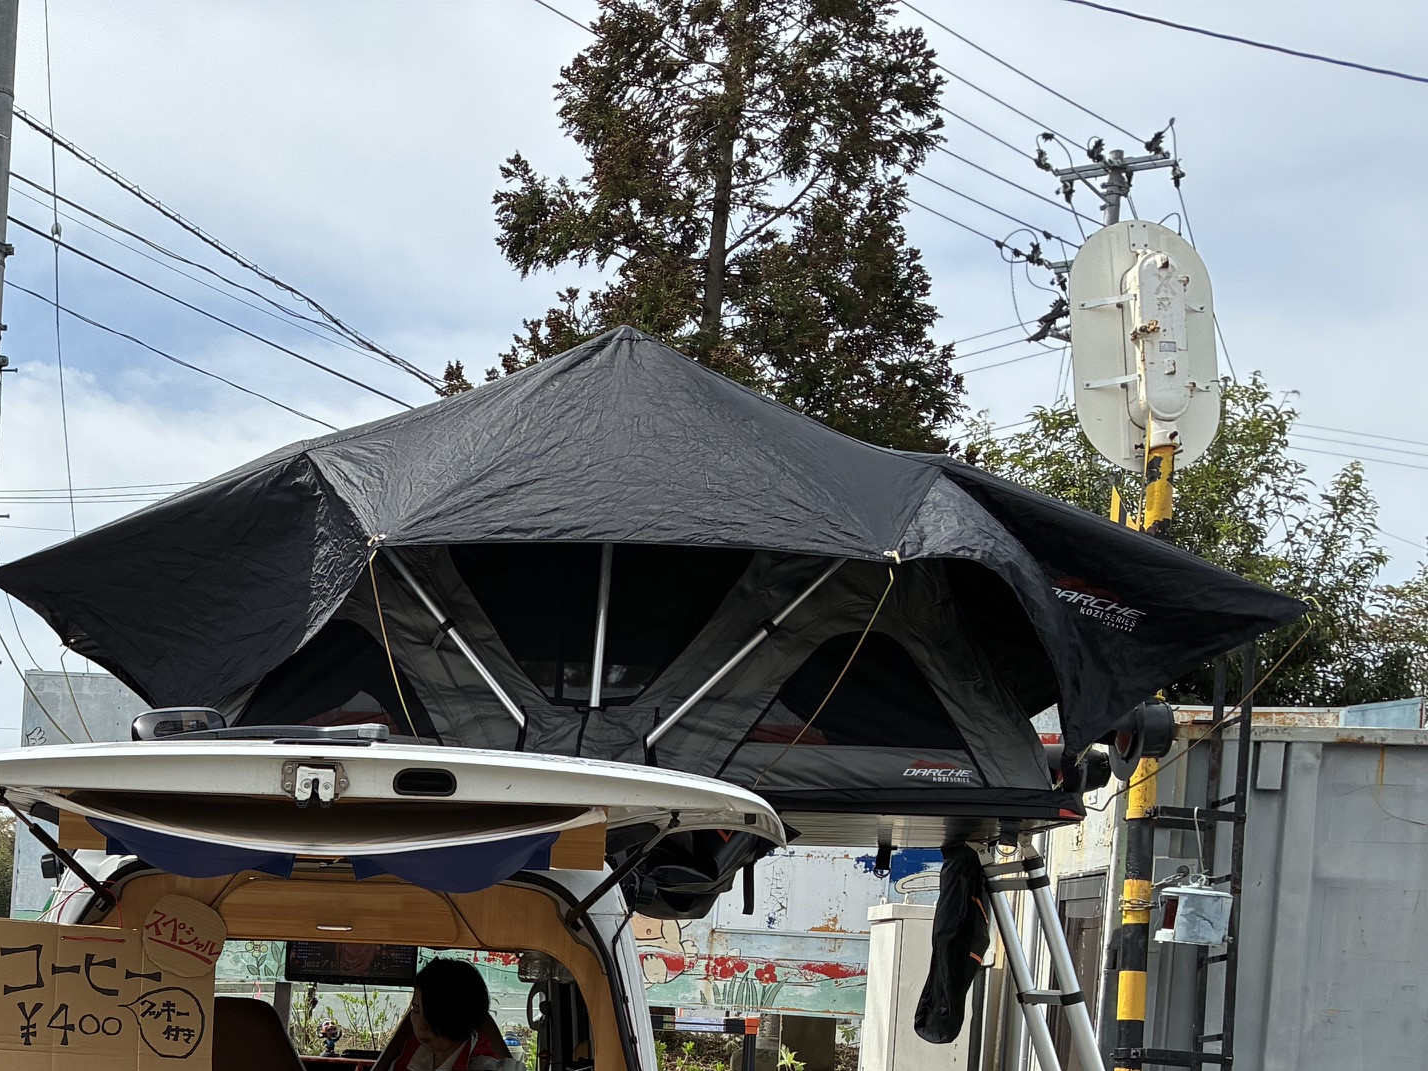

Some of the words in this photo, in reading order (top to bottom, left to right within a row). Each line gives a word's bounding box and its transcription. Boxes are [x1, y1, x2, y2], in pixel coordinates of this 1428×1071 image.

[1079, 606, 1104, 619] KOZI
[1104, 611, 1137, 628] SERIES
[902, 768, 973, 777] DARCHE
[144, 909, 222, 956] スペシャル
[0, 944, 162, 996] コーヒー
[140, 1000, 190, 1022] クッキー
[17, 1002, 122, 1046] ¥400
[162, 1025, 195, 1044] 付き
